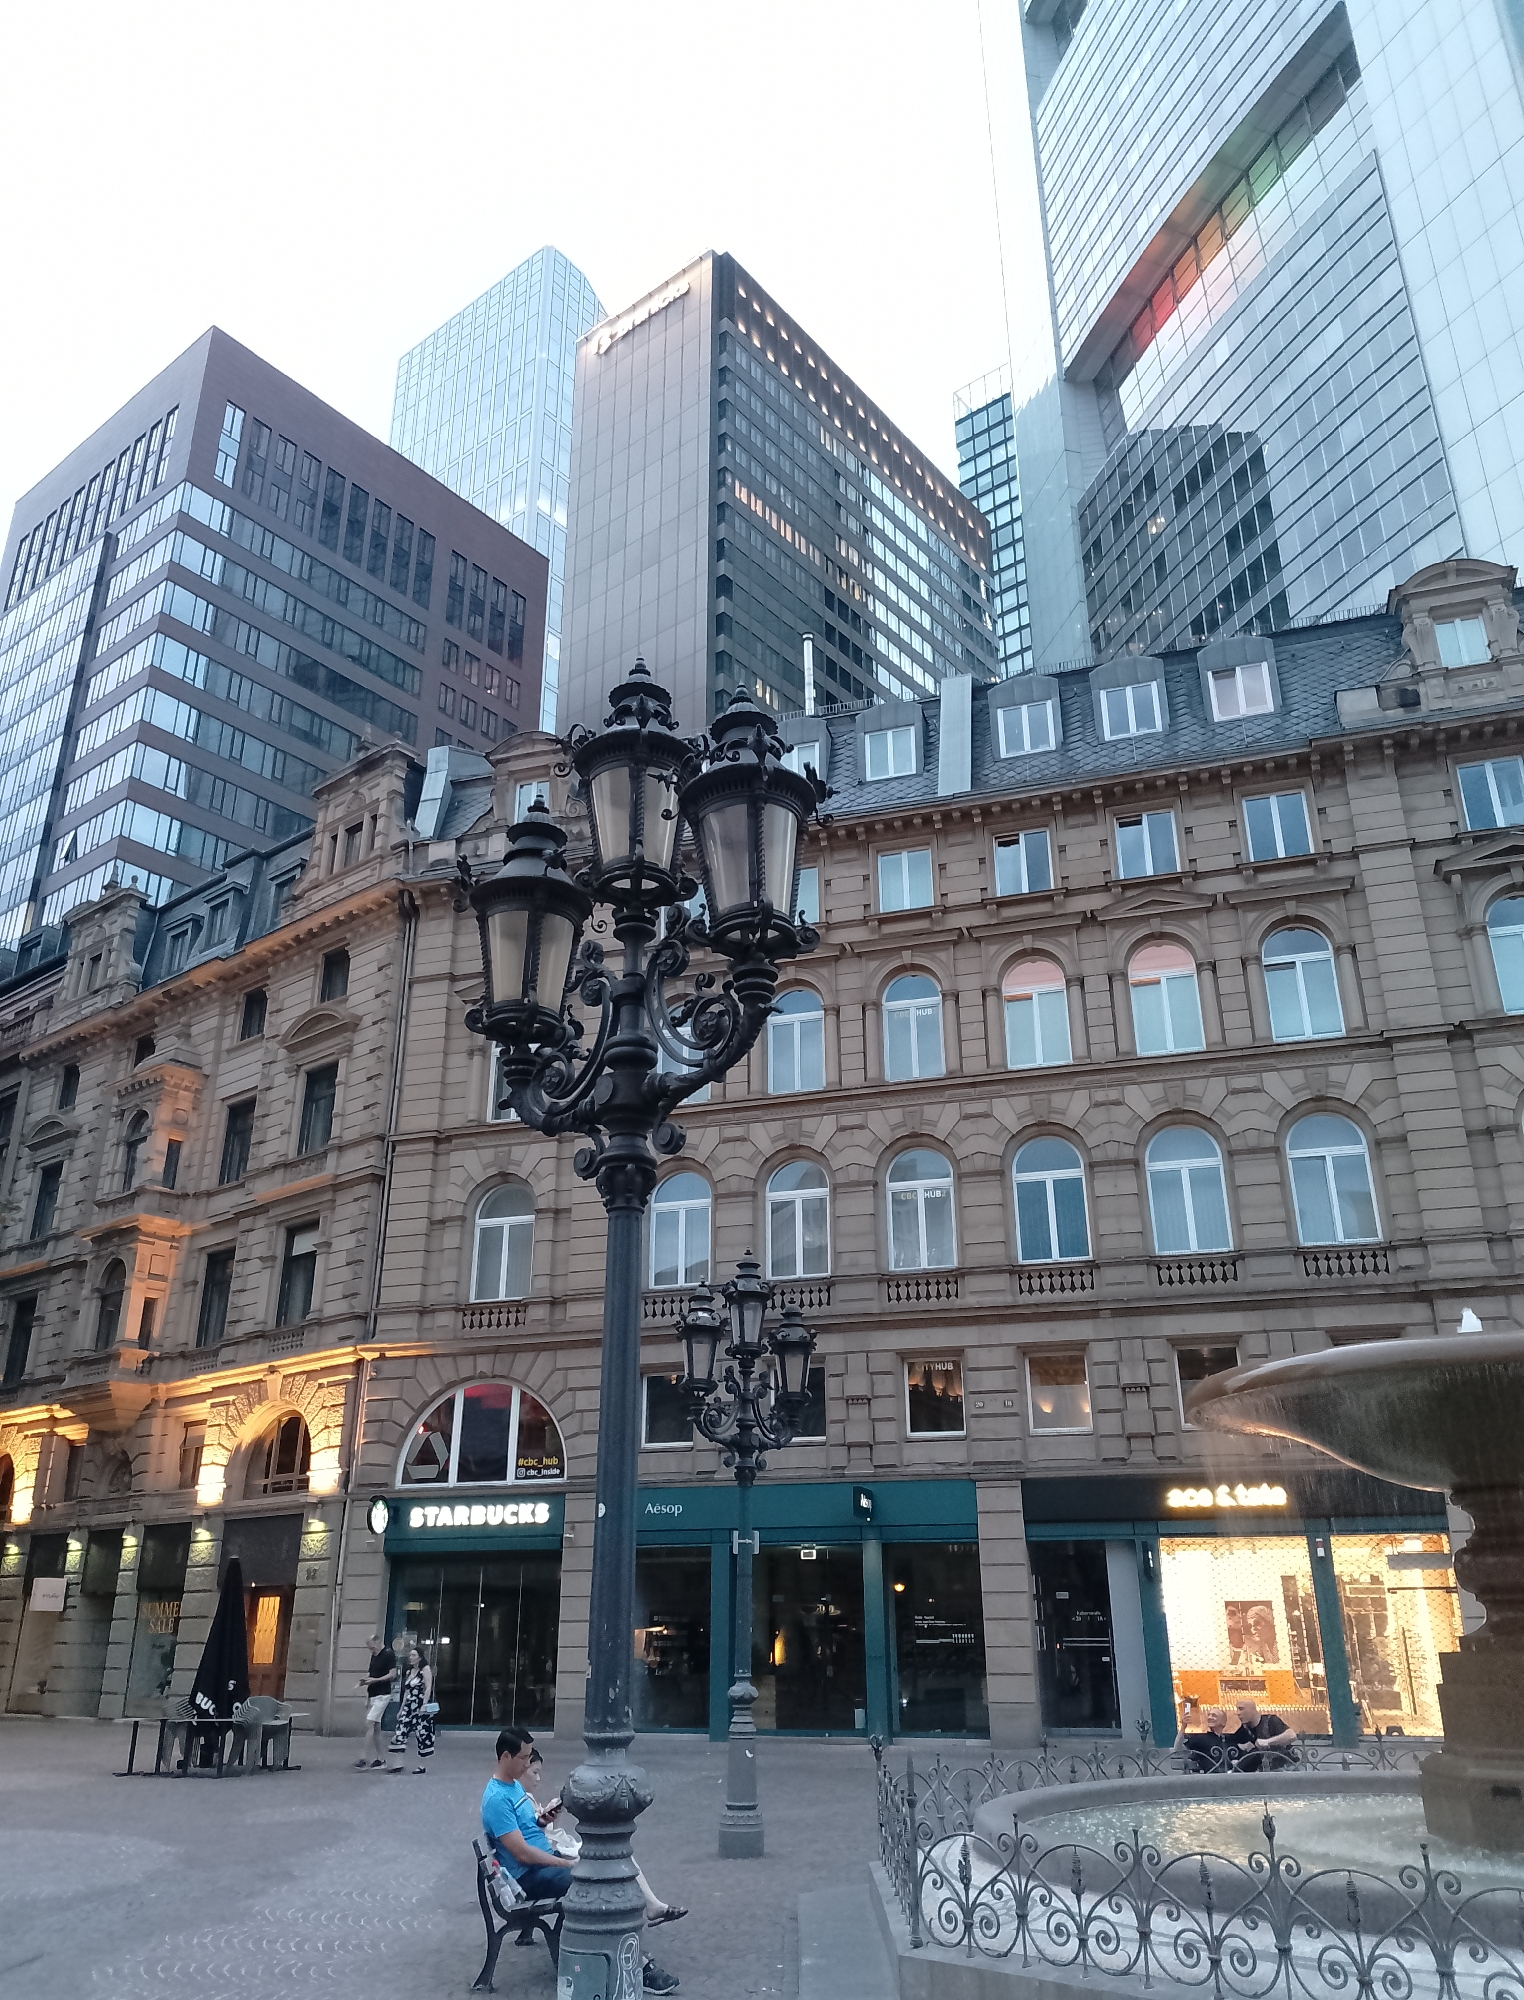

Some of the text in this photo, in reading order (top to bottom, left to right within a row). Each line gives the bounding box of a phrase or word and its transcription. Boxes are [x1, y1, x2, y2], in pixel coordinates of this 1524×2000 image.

[517, 1456, 559, 1467] #cbc_hub
[1167, 1488, 1213, 1508] ace
[409, 1502, 550, 1528] STARBUCKS
[645, 1502, 683, 1517] Aēsop
[140, 1601, 180, 1618] SUMME
